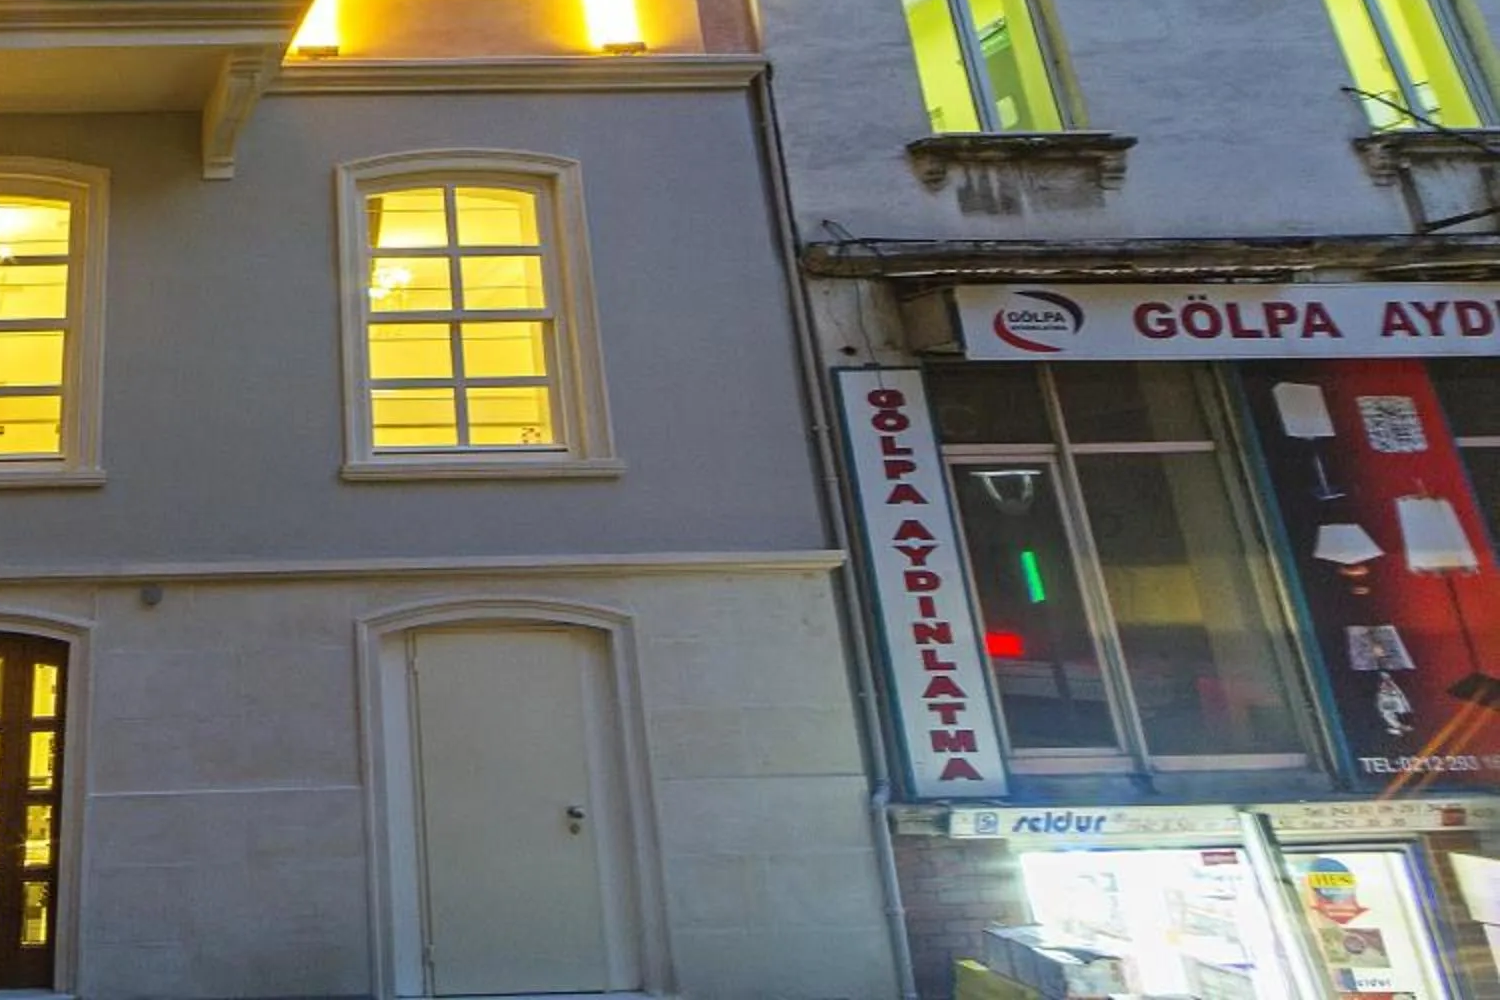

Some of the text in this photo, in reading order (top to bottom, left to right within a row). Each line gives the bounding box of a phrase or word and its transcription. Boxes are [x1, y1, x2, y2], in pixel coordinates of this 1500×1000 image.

[1007, 310, 1066, 323] GÖLPA
[1133, 295, 1500, 339] GÖLPA AYD
[866, 389, 984, 781] GÖLPA AYDINLATMA
